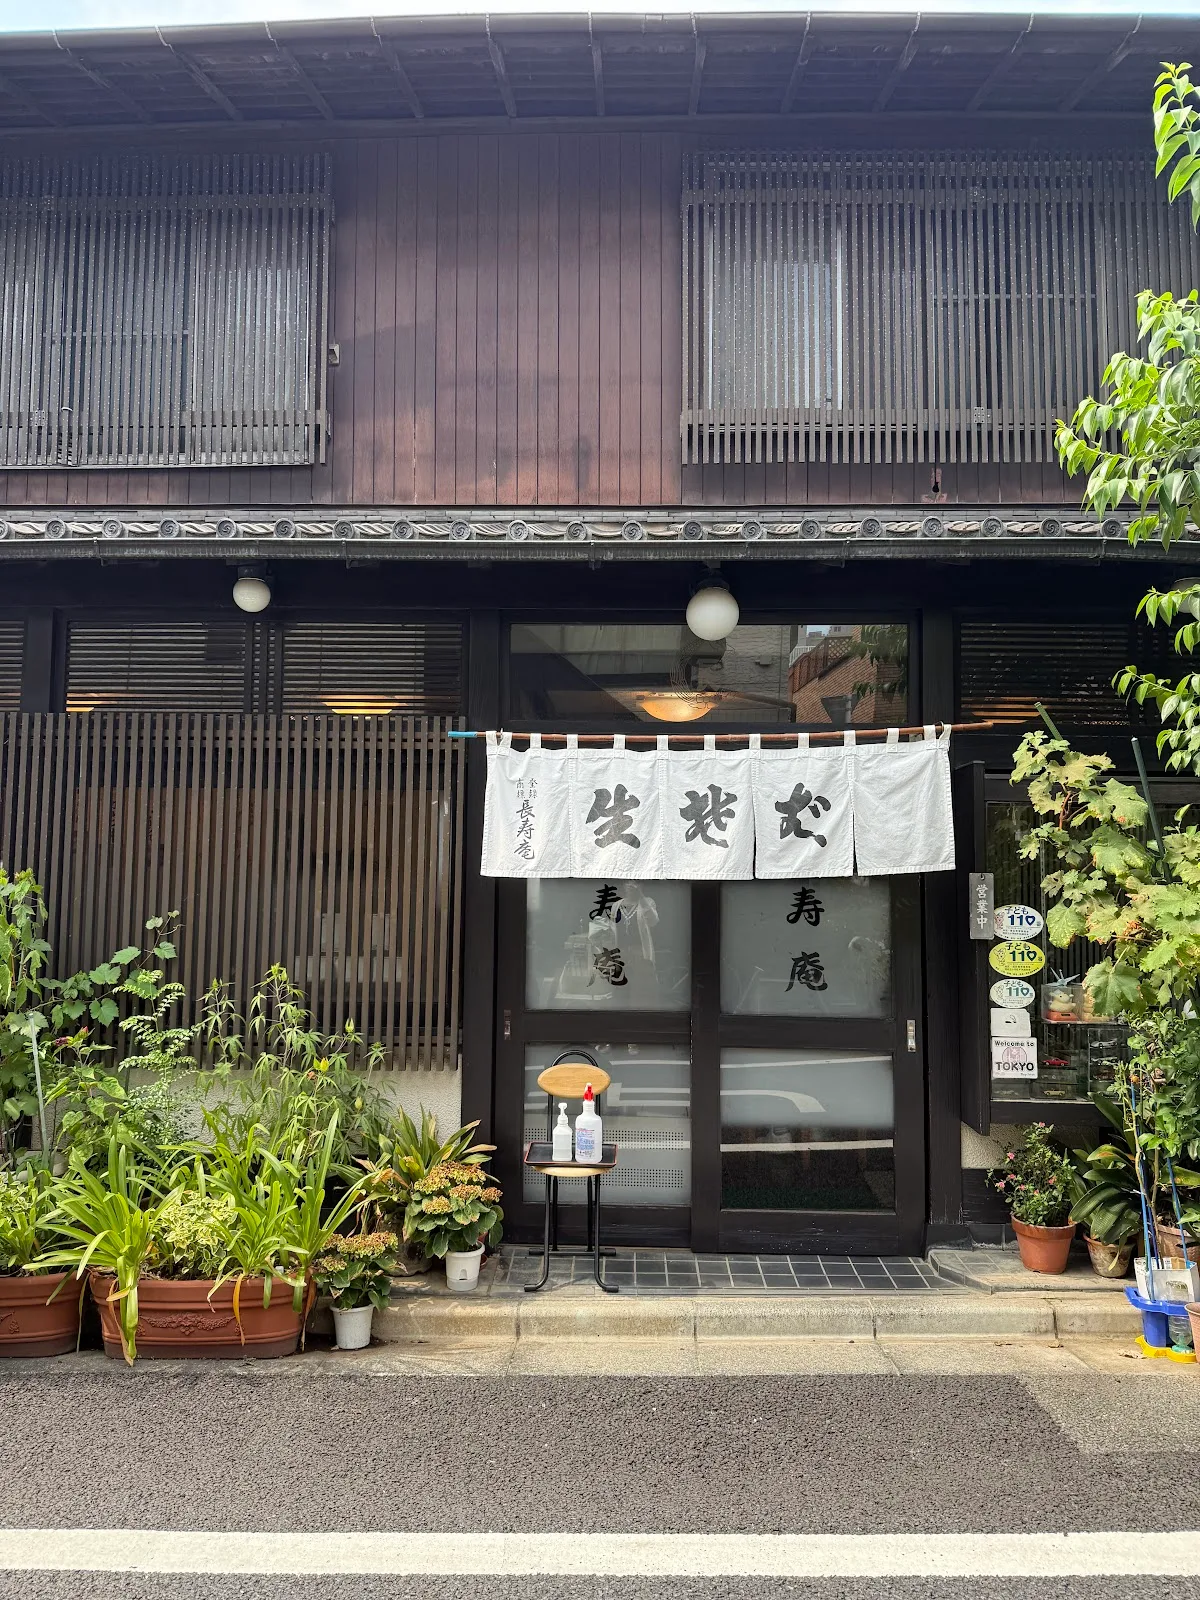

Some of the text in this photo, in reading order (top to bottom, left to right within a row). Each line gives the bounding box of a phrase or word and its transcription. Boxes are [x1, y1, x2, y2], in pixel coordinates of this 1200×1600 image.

[514, 800, 535, 860] 長寿庵
[976, 884, 989, 929] 営業中
[1005, 906, 1028, 914] 子ども
[784, 887, 828, 992] 寿庵
[1005, 942, 1030, 950] 子ども
[995, 1062, 1034, 1071] TOKYO
